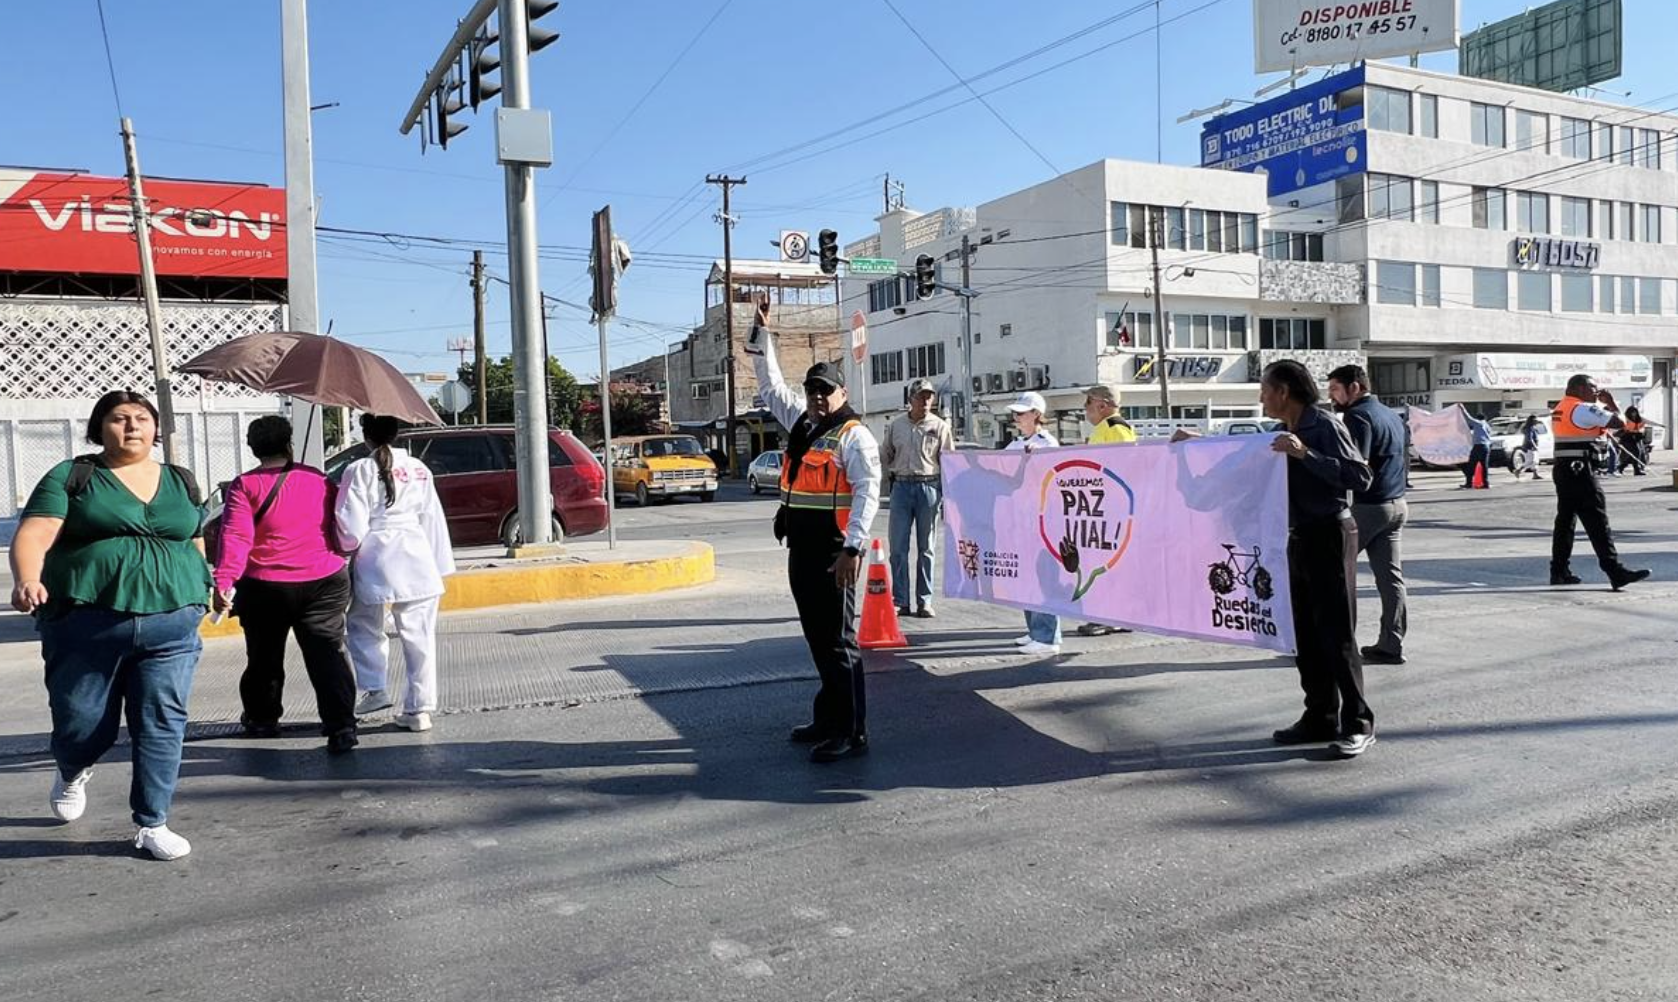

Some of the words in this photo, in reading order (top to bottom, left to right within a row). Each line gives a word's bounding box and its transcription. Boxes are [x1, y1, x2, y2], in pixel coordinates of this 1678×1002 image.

[1299, 0, 1412, 26] DISPONIBLE
[1396, 15, 1417, 32] 57
[1224, 124, 1254, 145] TODO
[1257, 103, 1313, 134] ELECTRIC
[207, 247, 227, 256] con
[1438, 377, 1474, 386] TEDSA
[1407, 394, 1431, 406] DIAZ
[1060, 489, 1105, 517] PAZ
[1065, 518, 1121, 551] VIAL!
[983, 559, 1018, 568] MOVILIDAD
[983, 567, 1018, 578] SEGURA
[1214, 594, 1260, 615] Ruedas
[1211, 609, 1277, 637] Desierto
